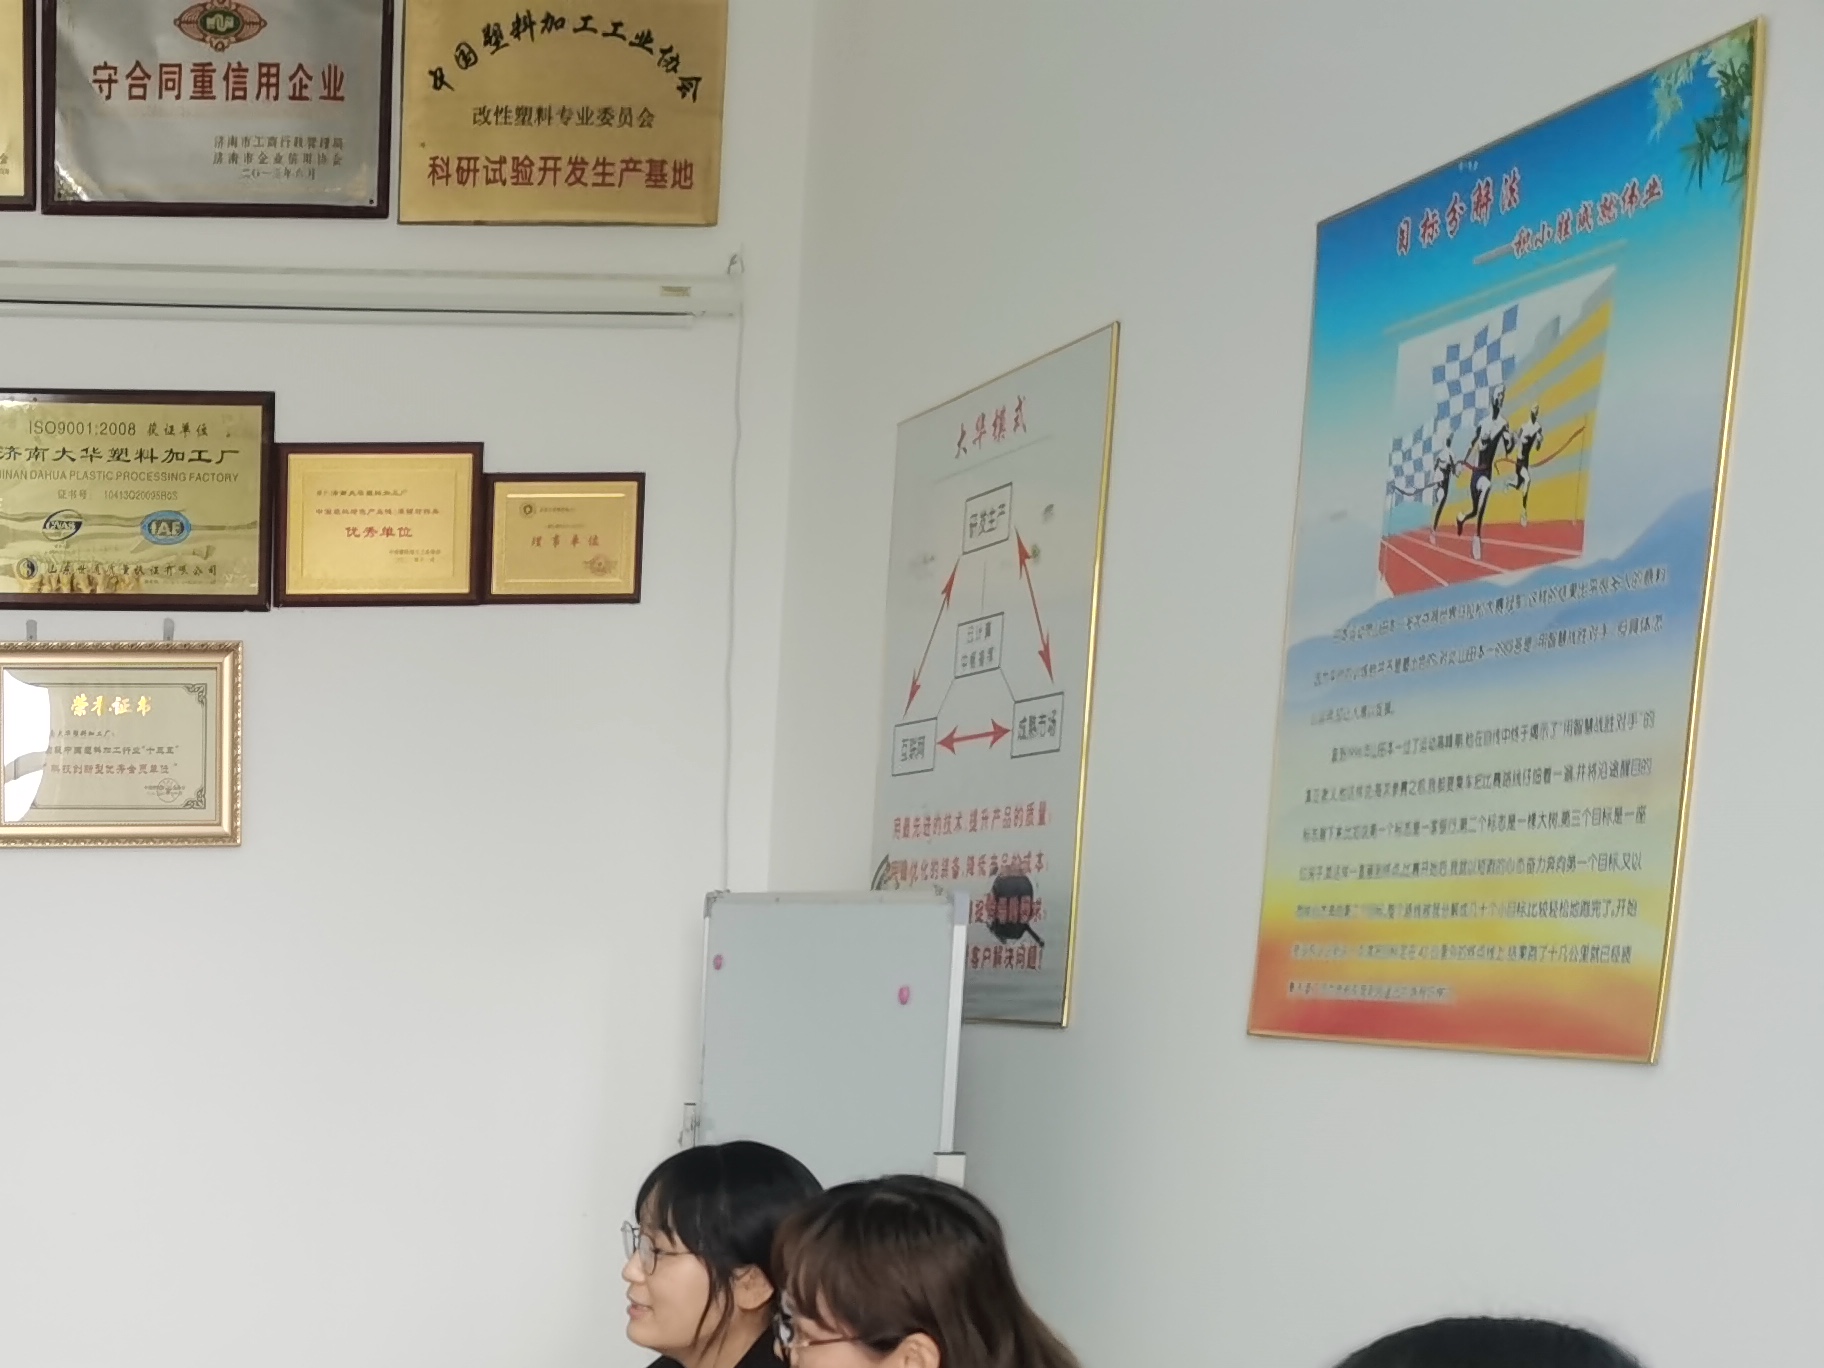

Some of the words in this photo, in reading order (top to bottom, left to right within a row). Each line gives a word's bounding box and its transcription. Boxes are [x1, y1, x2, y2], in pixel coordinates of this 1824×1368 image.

[92, 61, 345, 101] 守合同重信用企业
[472, 105, 656, 128] 改性塑料专业委员会
[427, 155, 695, 190] 科研试验开发生产基地
[1395, 168, 1522, 256] 目标分解法
[29, 421, 136, 436] ISO9001:2008
[146, 422, 209, 438] 获证单位
[954, 395, 1029, 459] 大华模式
[30, 470, 67, 481] DAHUA
[69, 470, 113, 481] PLASTIC
[115, 471, 187, 482] PROCESSING
[189, 472, 240, 482] FACTORY
[345, 526, 413, 538] 优秀单位
[70, 692, 153, 717] 荣誉证书
